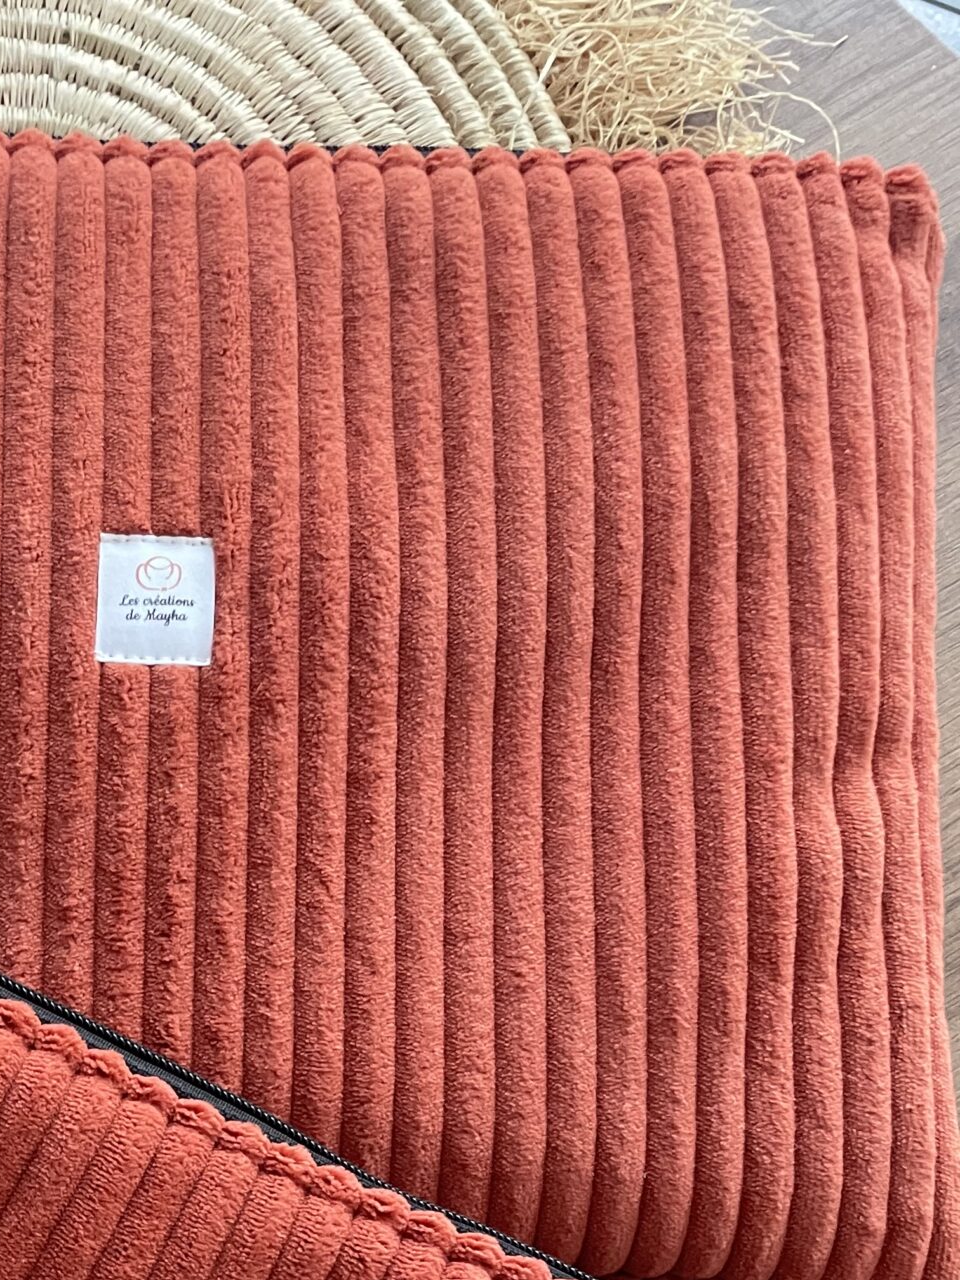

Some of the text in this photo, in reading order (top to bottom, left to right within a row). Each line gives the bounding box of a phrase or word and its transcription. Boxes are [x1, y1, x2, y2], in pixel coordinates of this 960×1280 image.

[118, 592, 195, 607] Les créations
[125, 607, 188, 627] de Mayha
